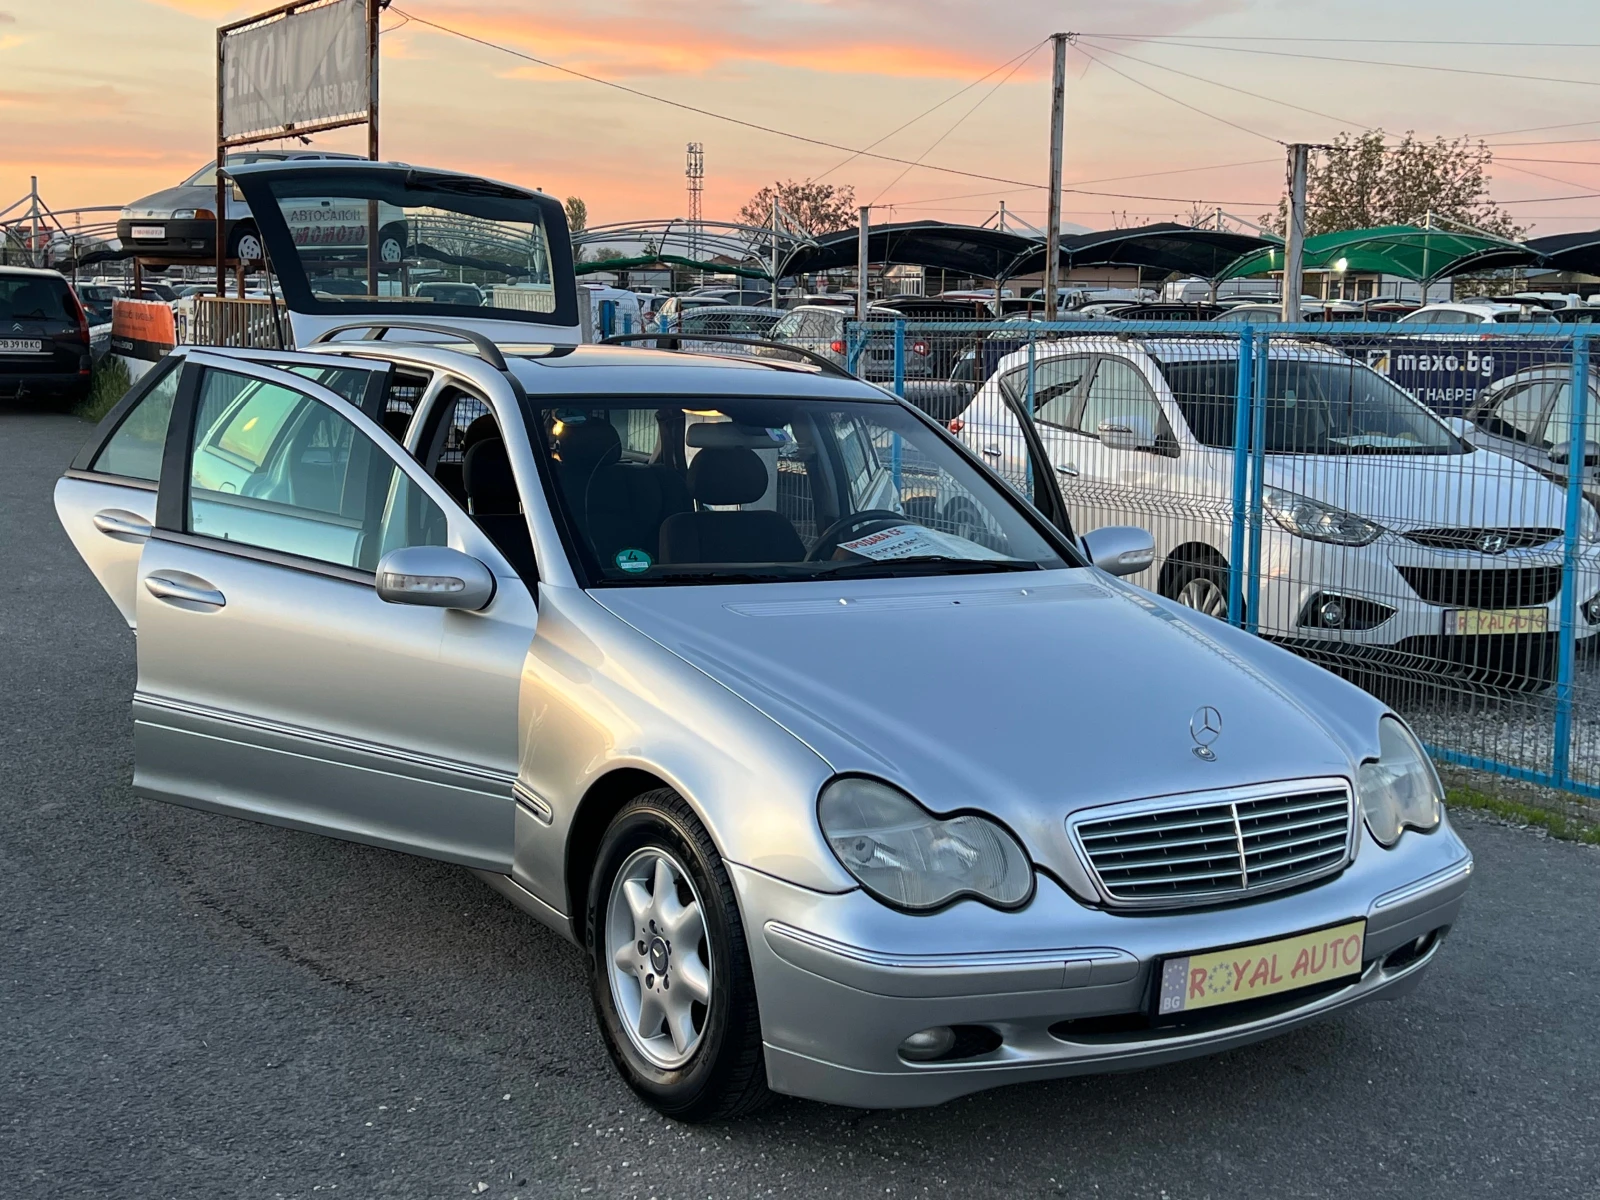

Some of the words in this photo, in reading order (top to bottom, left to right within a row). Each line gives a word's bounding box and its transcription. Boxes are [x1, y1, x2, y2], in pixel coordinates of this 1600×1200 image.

[10, 341, 29, 349] 3918
[1397, 351, 1495, 377] maxo.bg
[627, 550, 638, 561] 4
[1508, 613, 1546, 630] AUTO
[1291, 934, 1361, 979] AUTO
[1163, 995, 1181, 1011] BG
